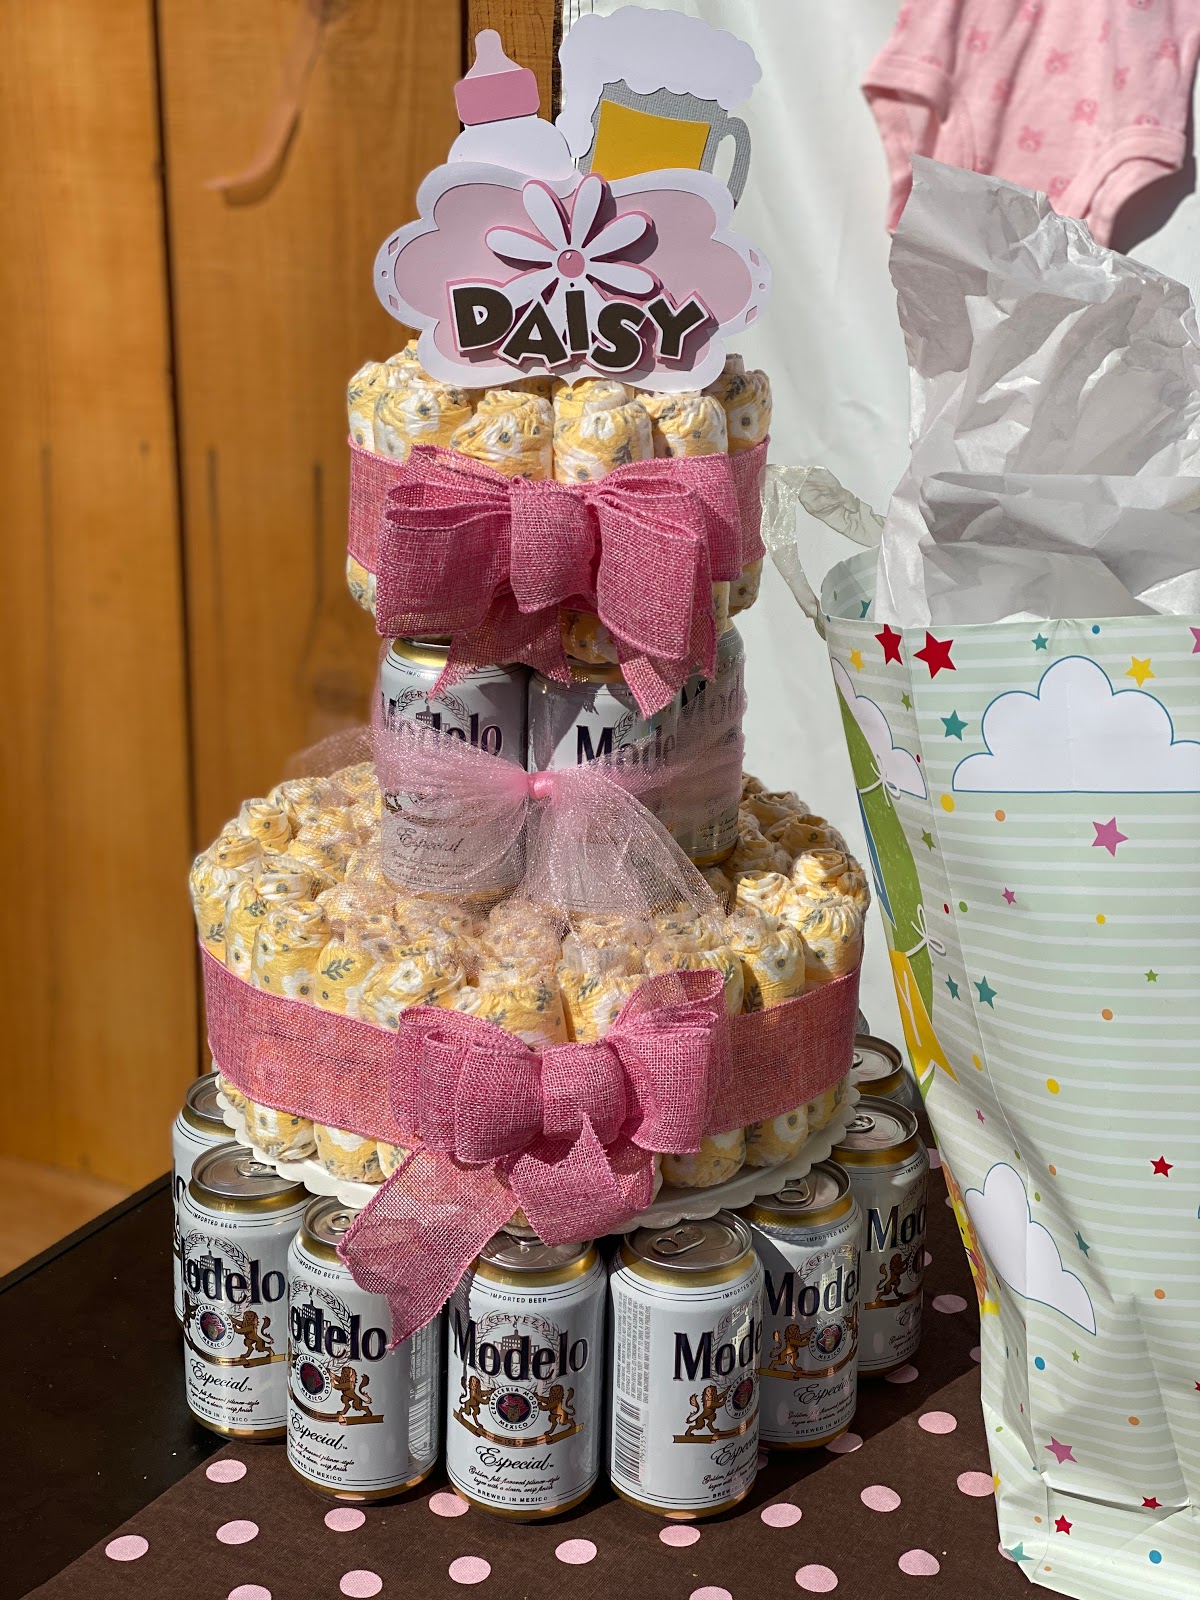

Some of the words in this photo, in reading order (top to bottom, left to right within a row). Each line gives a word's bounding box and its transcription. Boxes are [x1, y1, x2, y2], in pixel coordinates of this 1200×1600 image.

[450, 282, 709, 370] DAISY
[404, 689, 457, 707] CERZA
[381, 690, 503, 757] Melo
[192, 1212, 219, 1226] IMPORTED
[220, 1222, 238, 1230] BEER
[806, 1231, 837, 1242] IMPORTED
[838, 1224, 850, 1234] BEER
[181, 1236, 286, 1305] odelo
[297, 1260, 322, 1276] IMPORTED
[323, 1272, 340, 1280] BEER
[489, 1292, 526, 1304] IMPORTED
[722, 1283, 750, 1299] IMPORTED
[488, 1314, 550, 1331] CERVEZA
[290, 1305, 387, 1362] odelo
[453, 1307, 589, 1382] Modelo
[819, 1347, 841, 1360] MEXICO
[300, 1387, 323, 1400] MEXICO
[523, 1391, 539, 1419] MODELO
[290, 1408, 346, 1450] Especial
[499, 1419, 529, 1430] MEXICO
[795, 1426, 824, 1435] BREWED
[711, 1431, 758, 1466] Especi
[475, 1445, 552, 1473] Especial
[316, 1471, 342, 1482] MEXICO
[477, 1488, 506, 1501] BREWED
